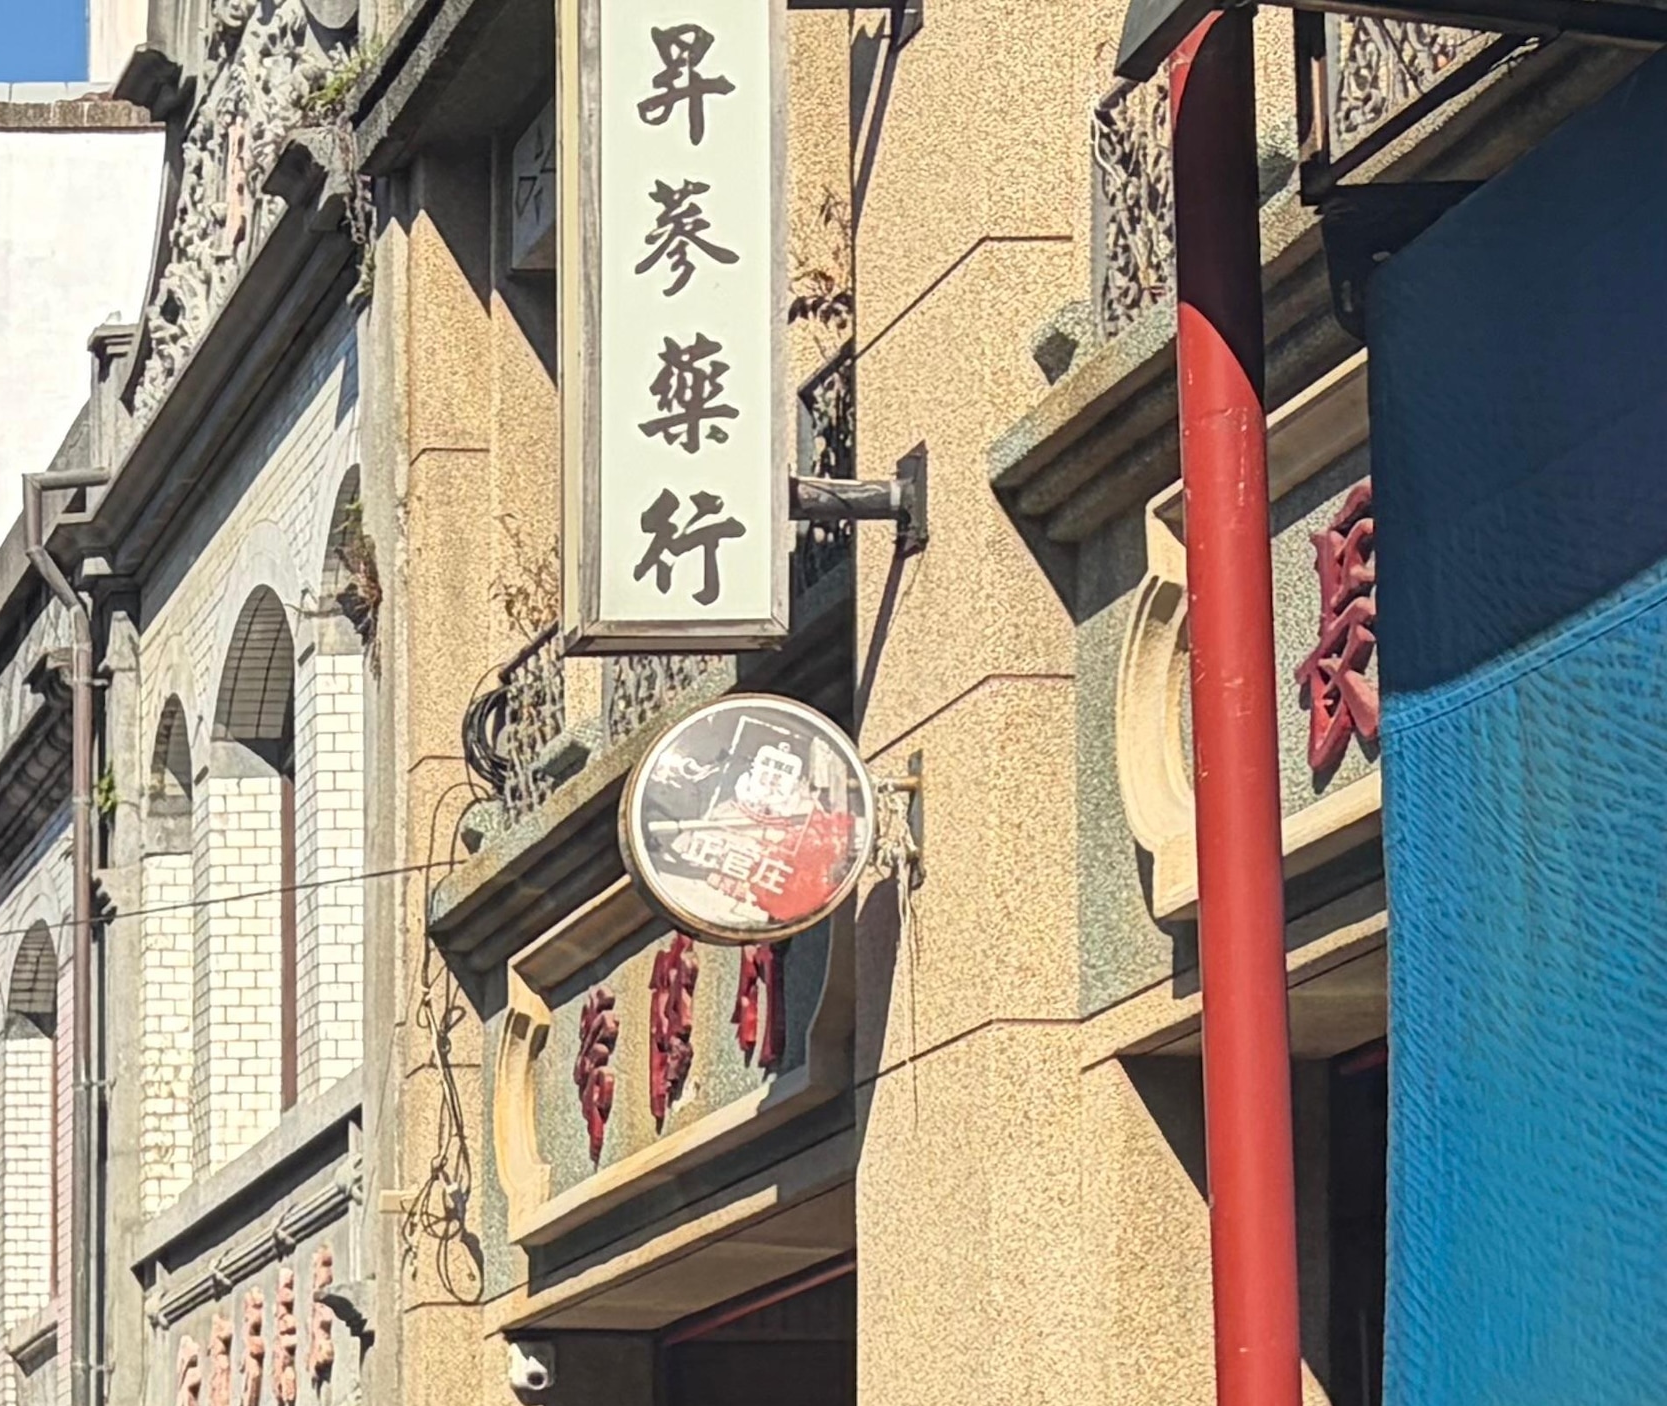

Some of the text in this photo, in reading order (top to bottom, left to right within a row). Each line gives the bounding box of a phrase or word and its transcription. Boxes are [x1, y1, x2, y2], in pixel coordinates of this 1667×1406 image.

[634, 24, 748, 606] 昇蔘藥行
[681, 830, 794, 895] 正官庄
